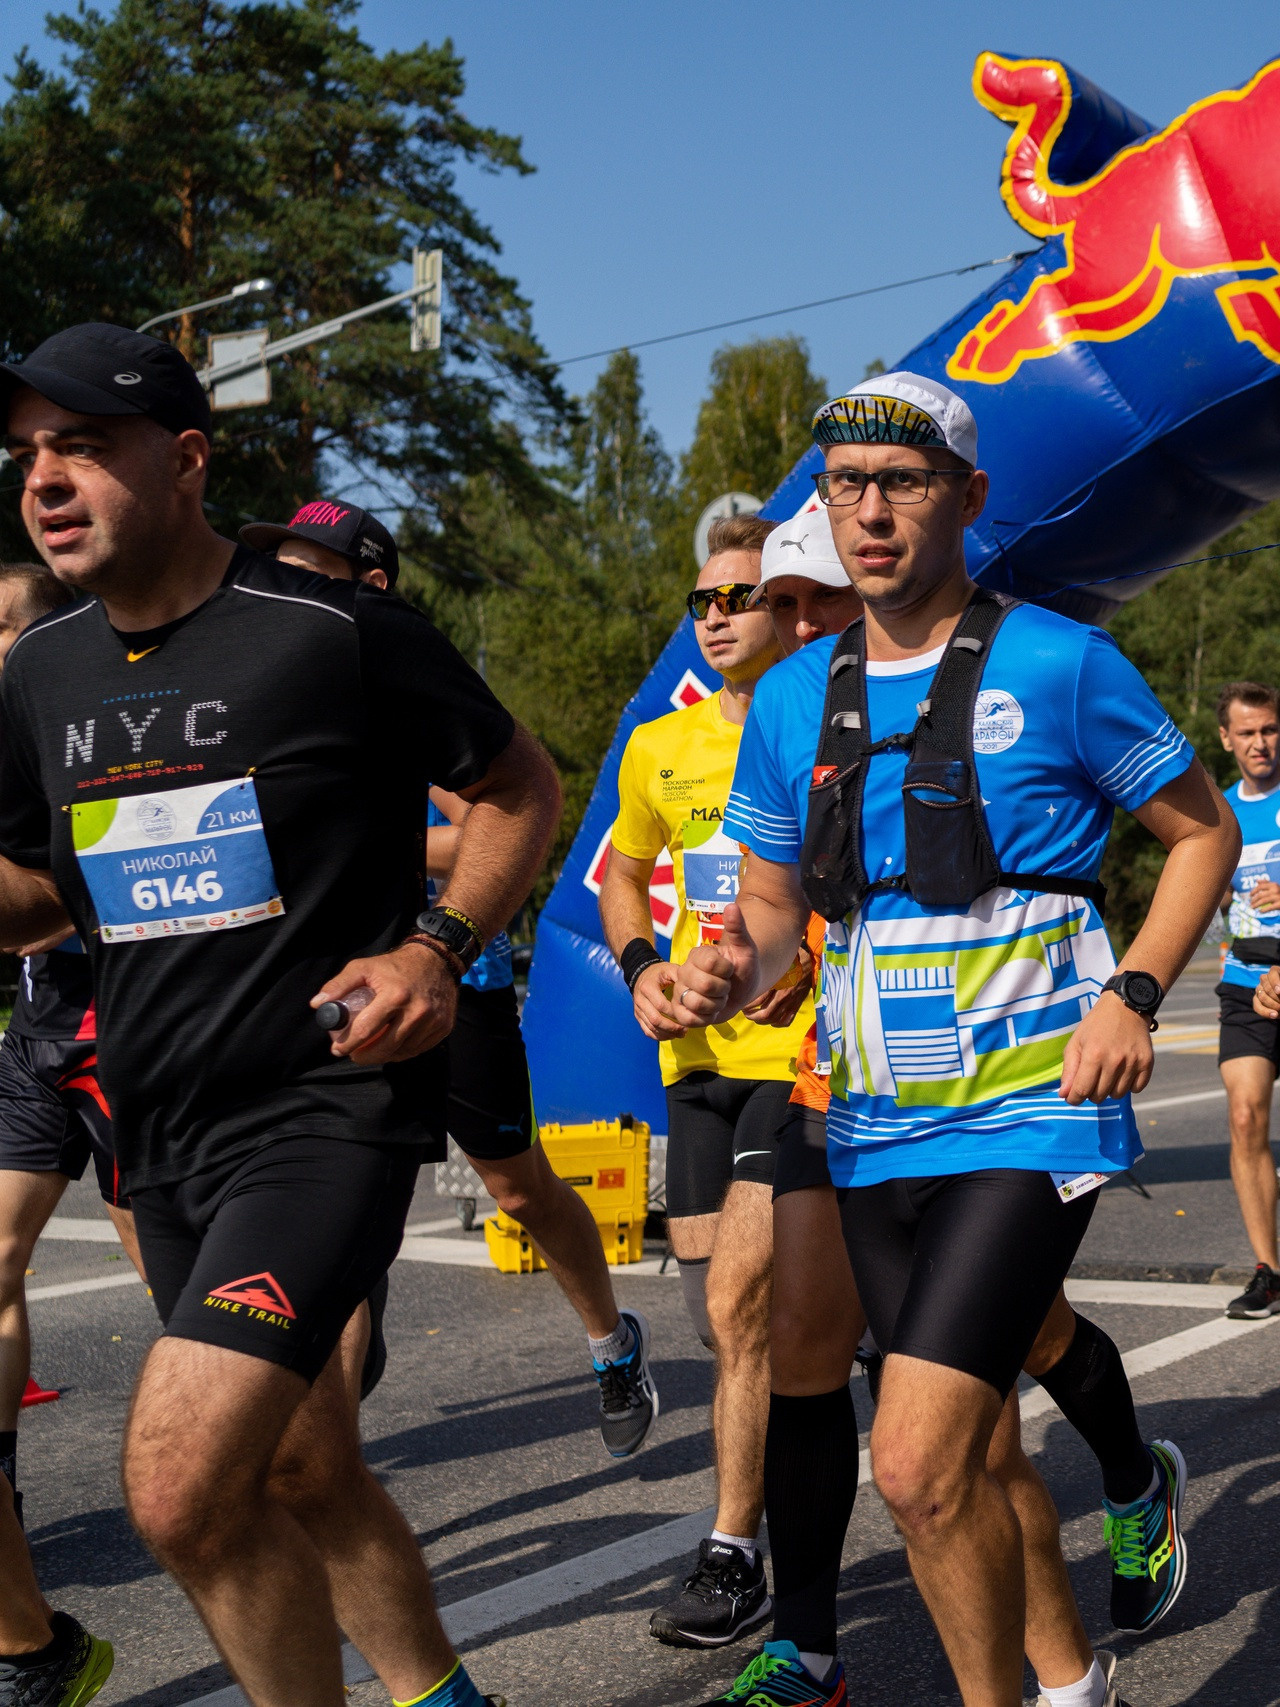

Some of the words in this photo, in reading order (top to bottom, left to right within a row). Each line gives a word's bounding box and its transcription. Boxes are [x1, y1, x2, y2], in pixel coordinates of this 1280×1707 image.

[107, 766, 122, 775] NEW
[123, 763, 143, 772] YORK
[663, 778, 705, 786] МОСКОВСКИЙ
[204, 811, 226, 830] 21
[122, 845, 219, 875] НИКОЛАЙ
[719, 860, 740, 871] НИ
[131, 870, 224, 911] 6146
[445, 907, 467, 924] ЦСКА
[203, 1296, 243, 1313] NIKE
[247, 1307, 290, 1329] TRAIL
